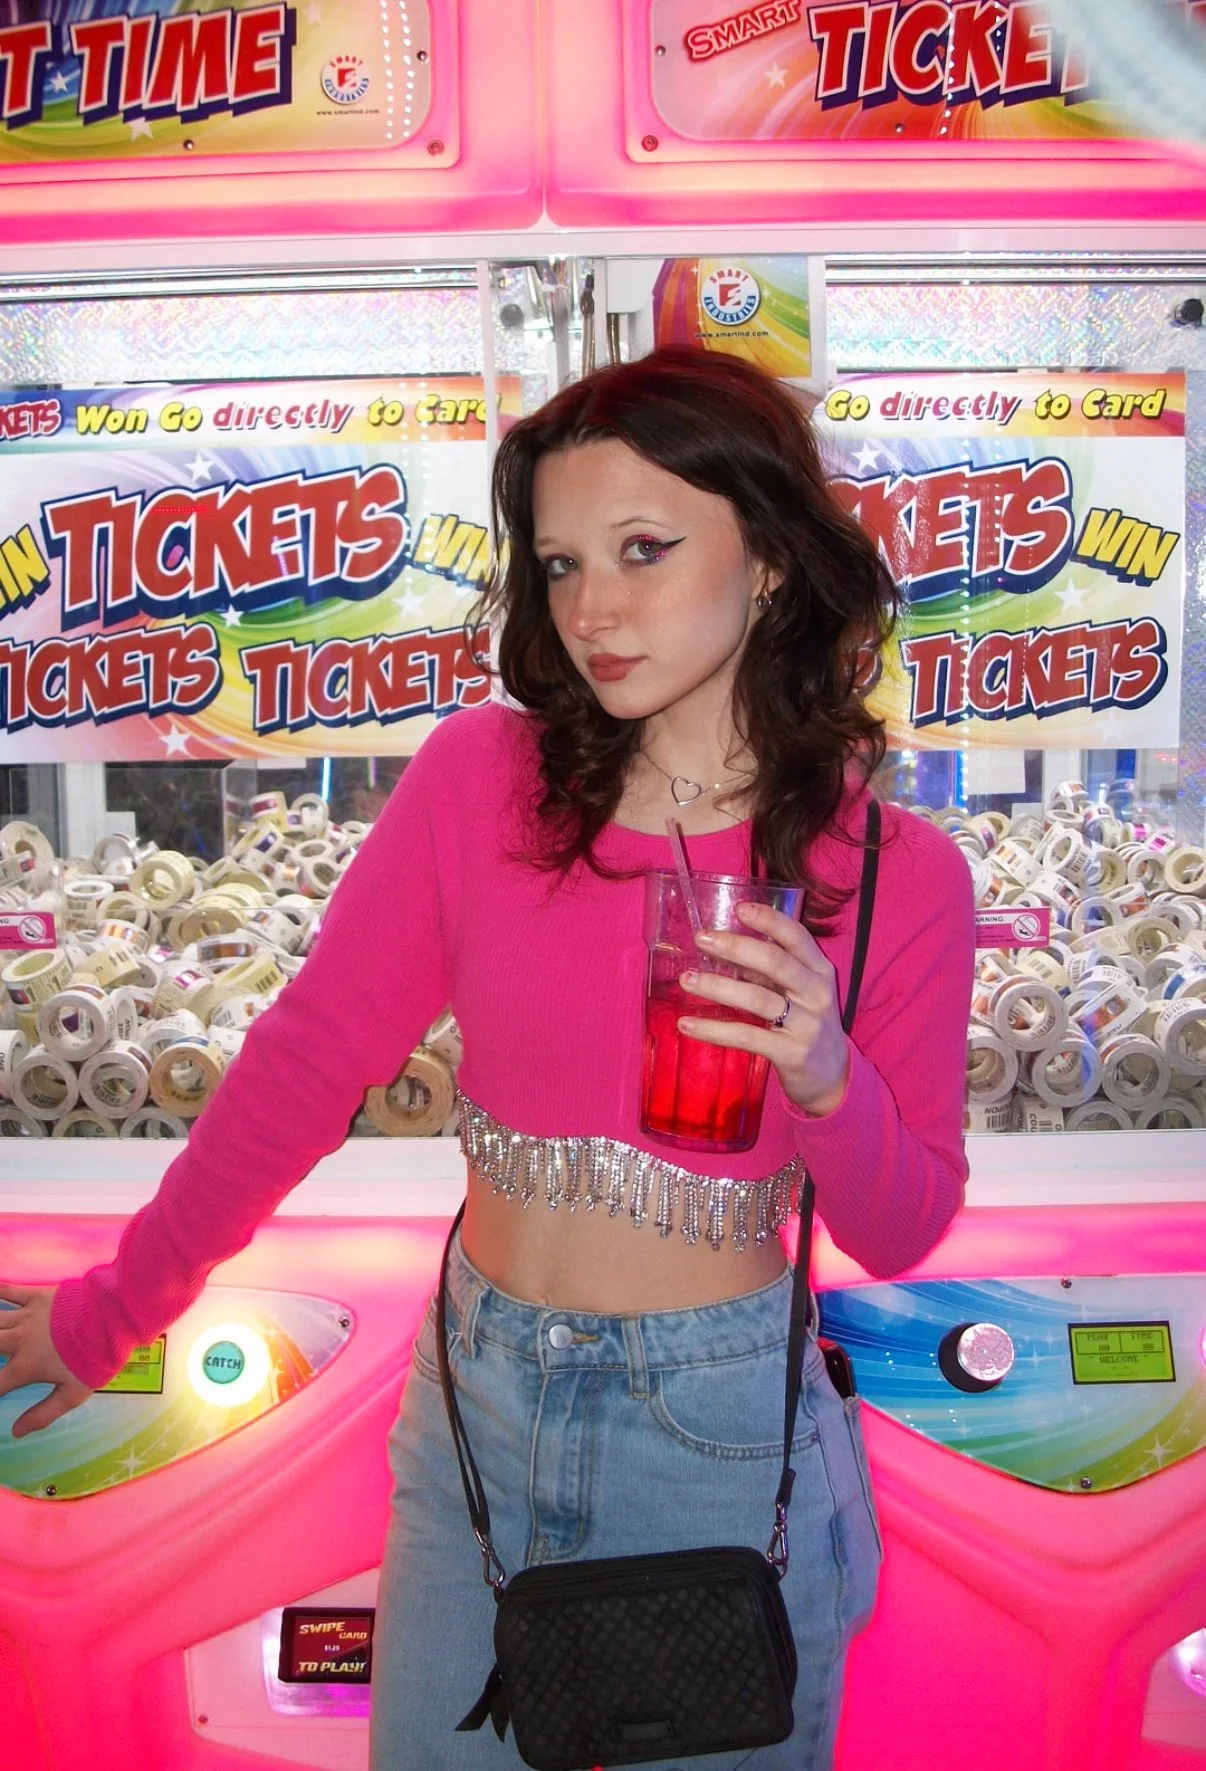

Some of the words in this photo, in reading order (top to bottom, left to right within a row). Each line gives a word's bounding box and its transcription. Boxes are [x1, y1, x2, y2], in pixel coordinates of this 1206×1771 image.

[686, 0, 800, 60] SMART
[807, 0, 1092, 100] TICKE
[70, 3, 291, 116] TIME
[709, 268, 750, 284] SMART
[703, 294, 757, 323] INDUSTRIES
[695, 330, 769, 338] www.smartind.com
[76, 403, 147, 434] Won
[159, 402, 202, 431] Go
[213, 399, 354, 432] directly
[368, 394, 403, 428] to
[825, 389, 870, 421] Go
[879, 390, 1021, 425] directly
[1034, 388, 1071, 418] to
[1081, 388, 1167, 418] Card
[41, 464, 409, 625] TICKETS
[1072, 508, 1180, 585] WIN
[0, 524, 50, 612] IN
[241, 624, 491, 732] TICKETS
[900, 617, 1168, 727] TICKETS
[206, 1356, 242, 1369] CATCH
[1100, 1355, 1139, 1363] WELCOME
[299, 1621, 346, 1634] SWIPE
[298, 1661, 318, 1672] TO
[320, 1661, 367, 1673] PLAY!
